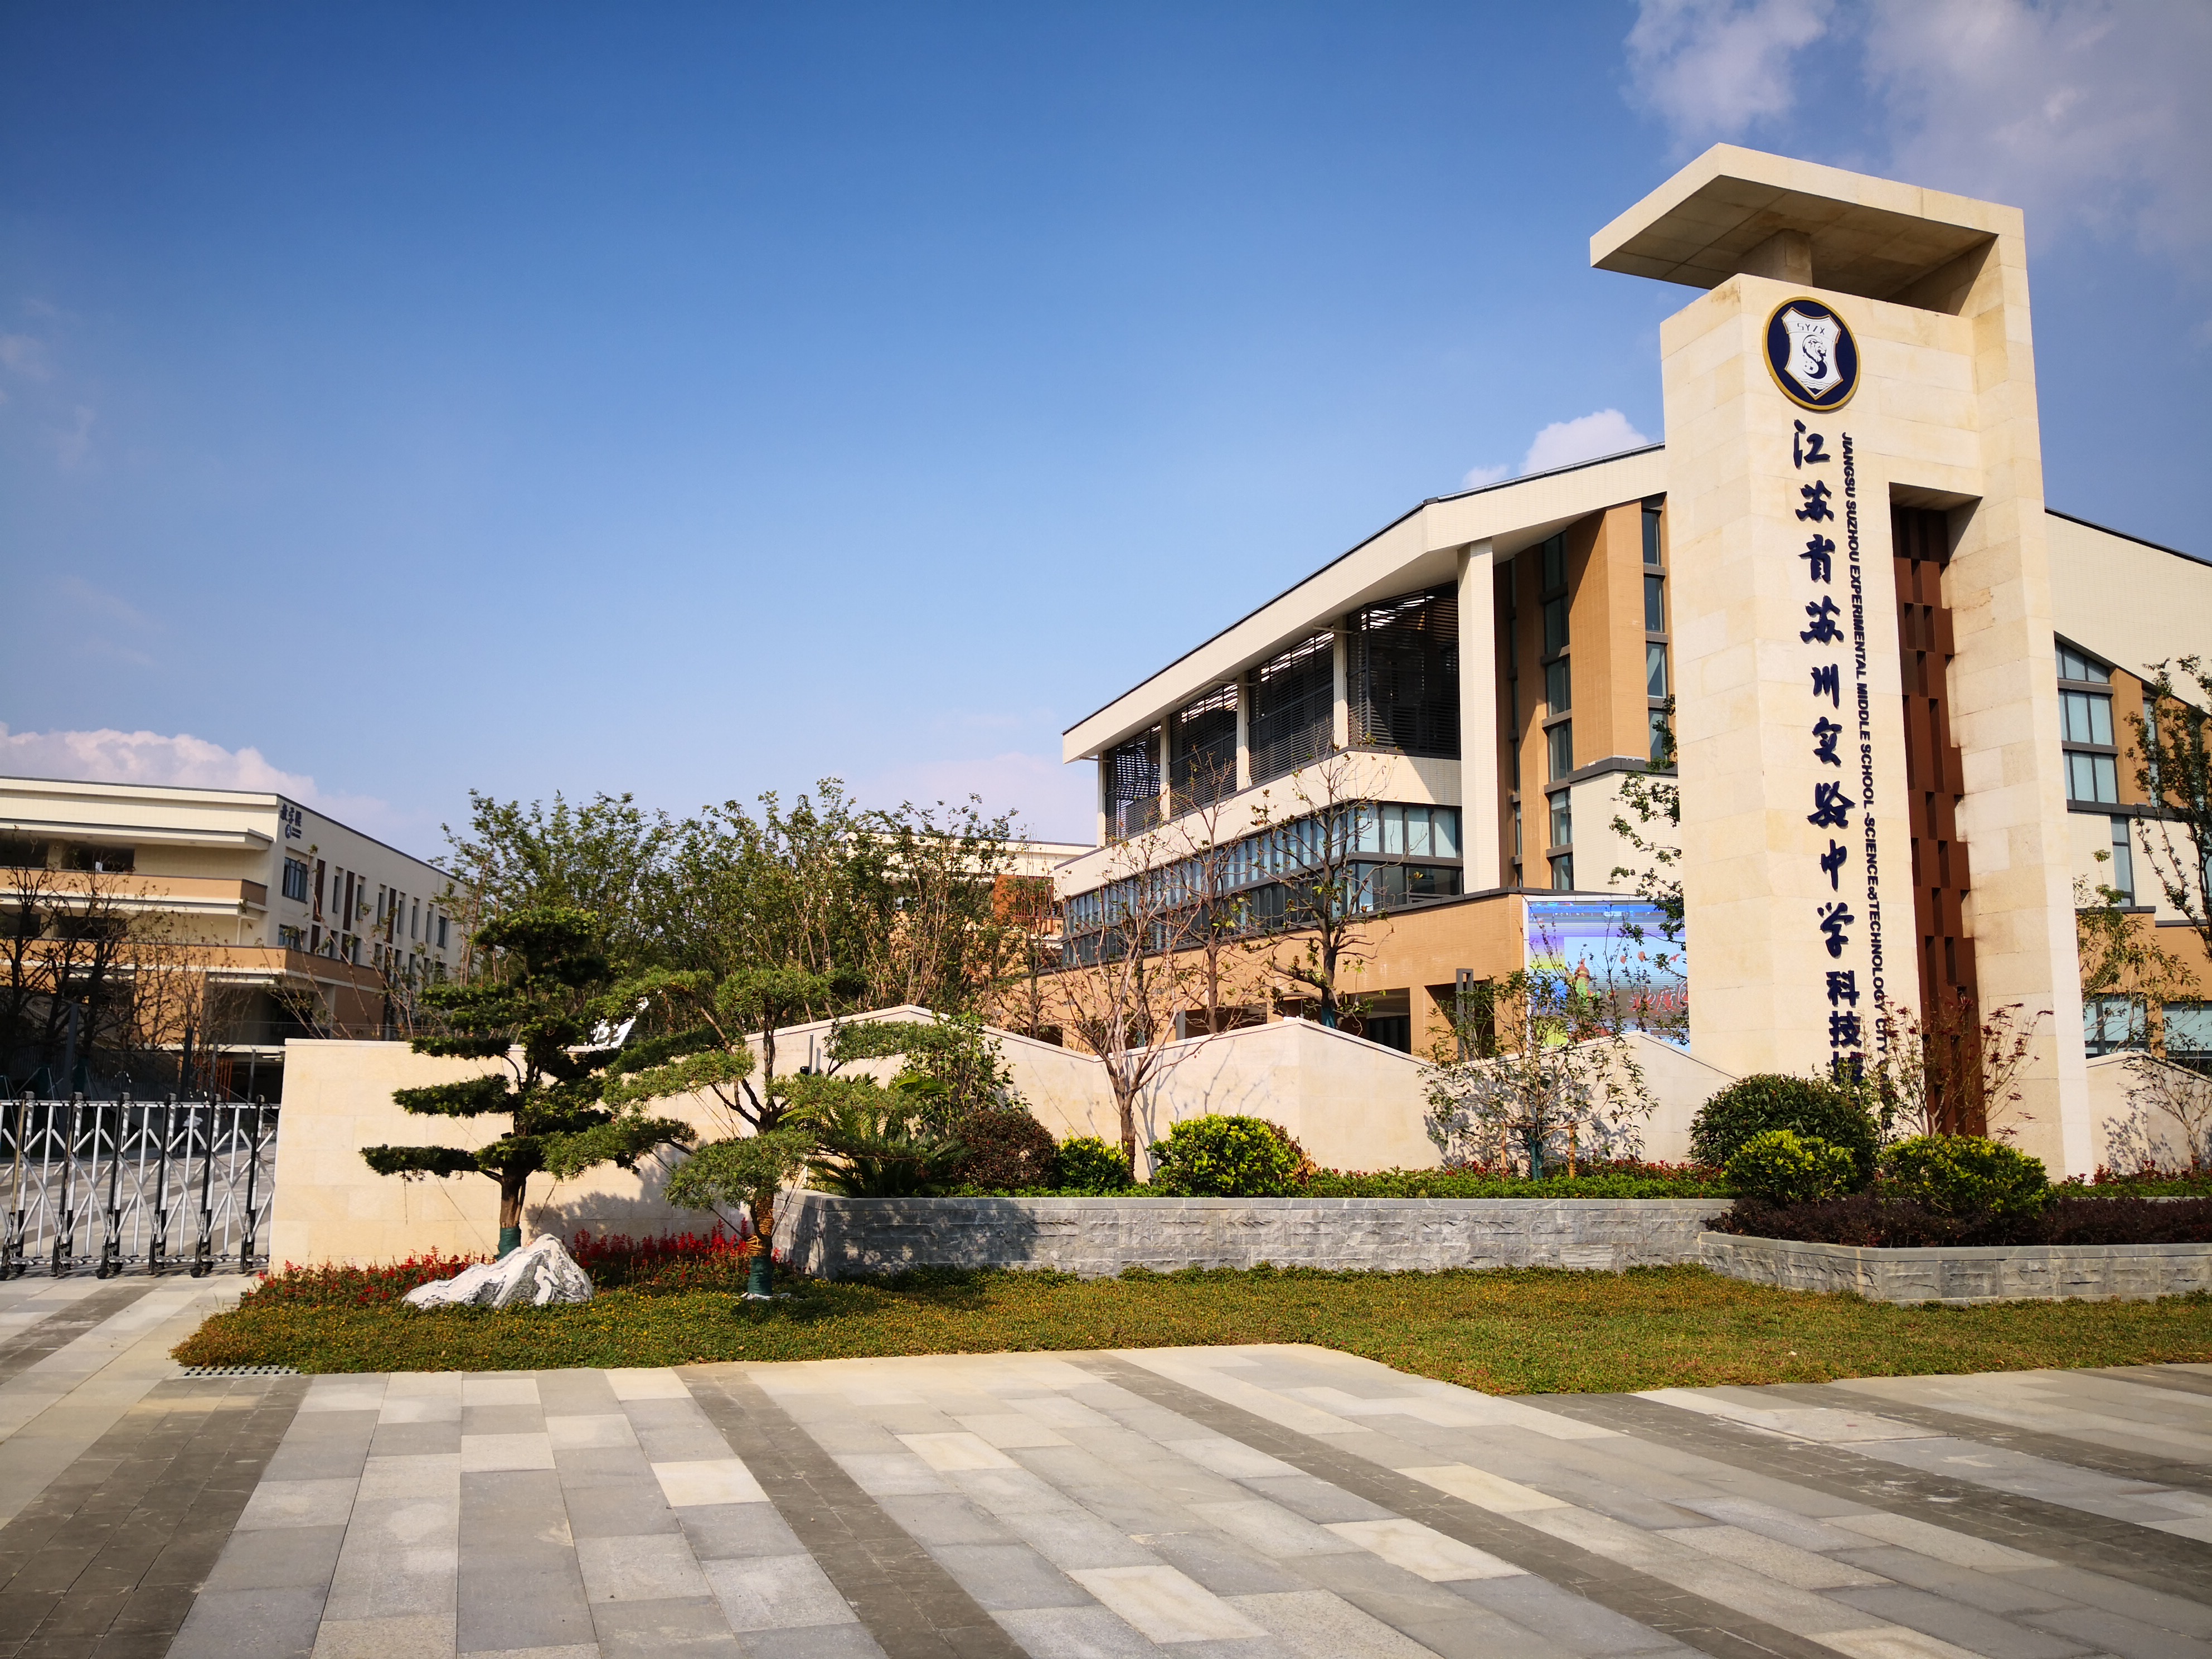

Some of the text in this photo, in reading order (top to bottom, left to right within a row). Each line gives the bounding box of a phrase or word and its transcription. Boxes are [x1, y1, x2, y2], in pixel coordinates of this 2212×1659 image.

[1842, 432, 1855, 498] JIANGSU
[1846, 500, 1860, 562] SUZHOU
[1850, 565, 1866, 680] EXPERIMENTAL
[1856, 683, 1870, 741] MIDDLE
[1860, 744, 1874, 809] SCHOOL
[1875, 1018, 1889, 1054] CITY
